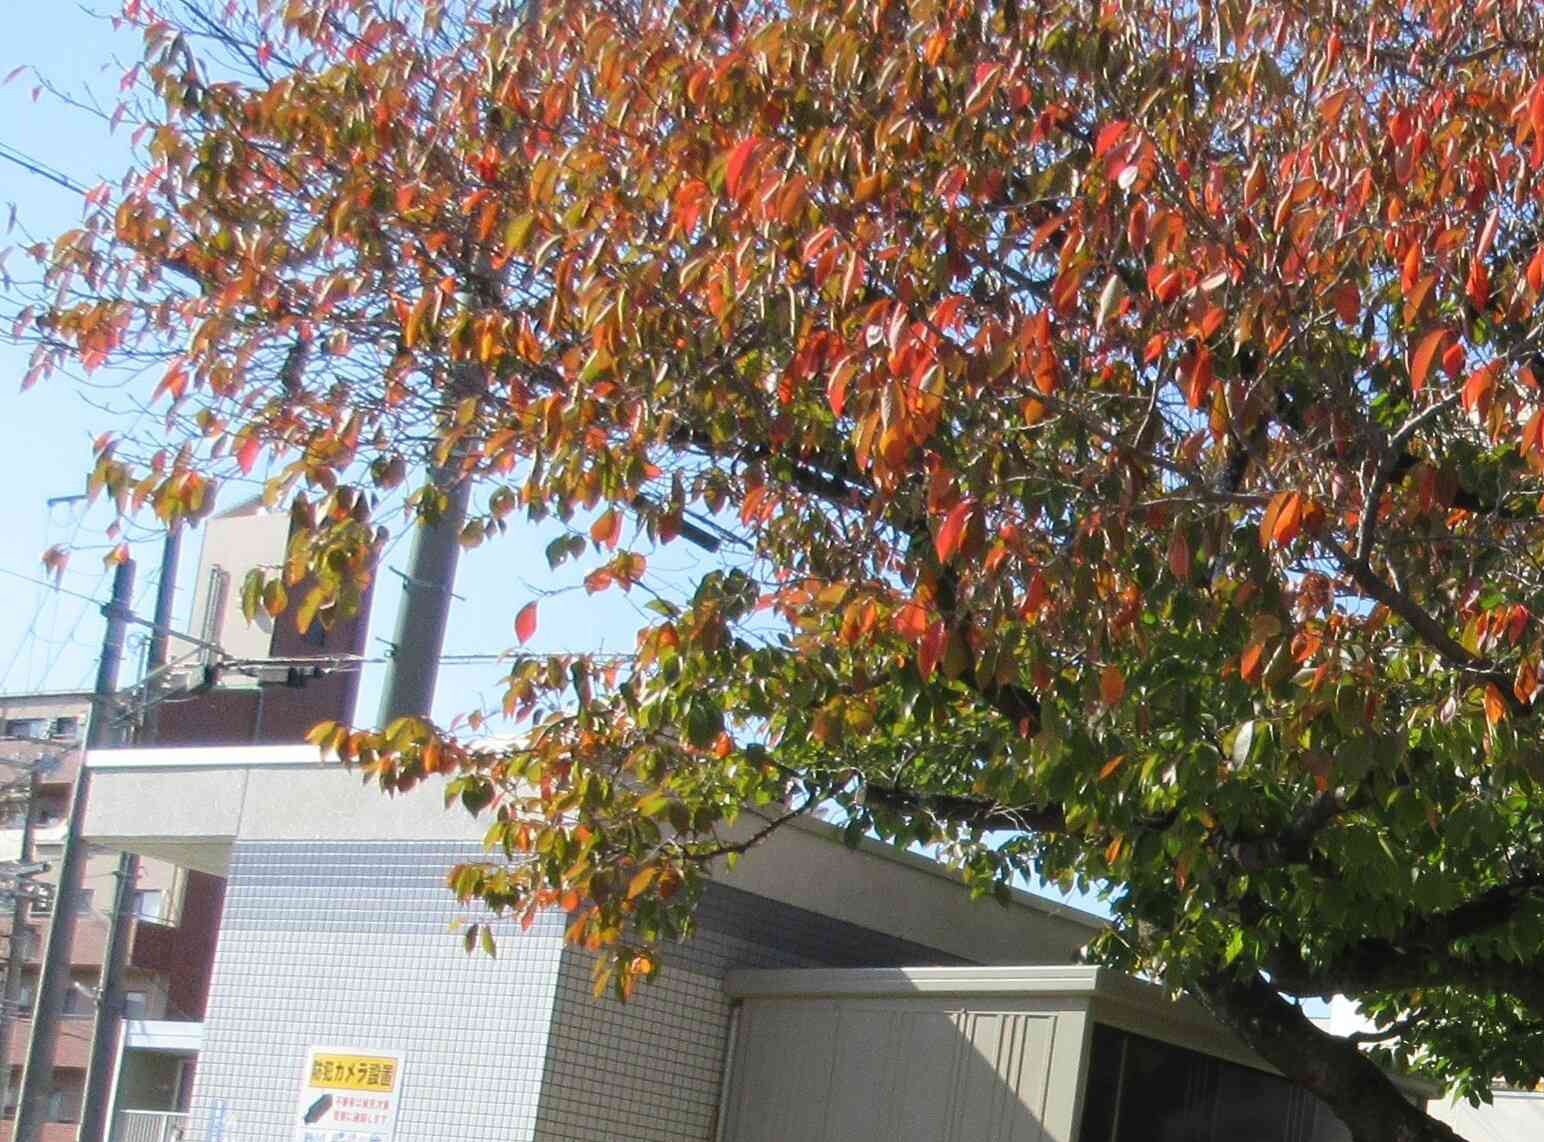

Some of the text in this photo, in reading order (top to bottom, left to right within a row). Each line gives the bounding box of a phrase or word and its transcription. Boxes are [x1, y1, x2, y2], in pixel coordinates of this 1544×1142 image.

[312, 1060, 393, 1087] 防犯カメラ設置
